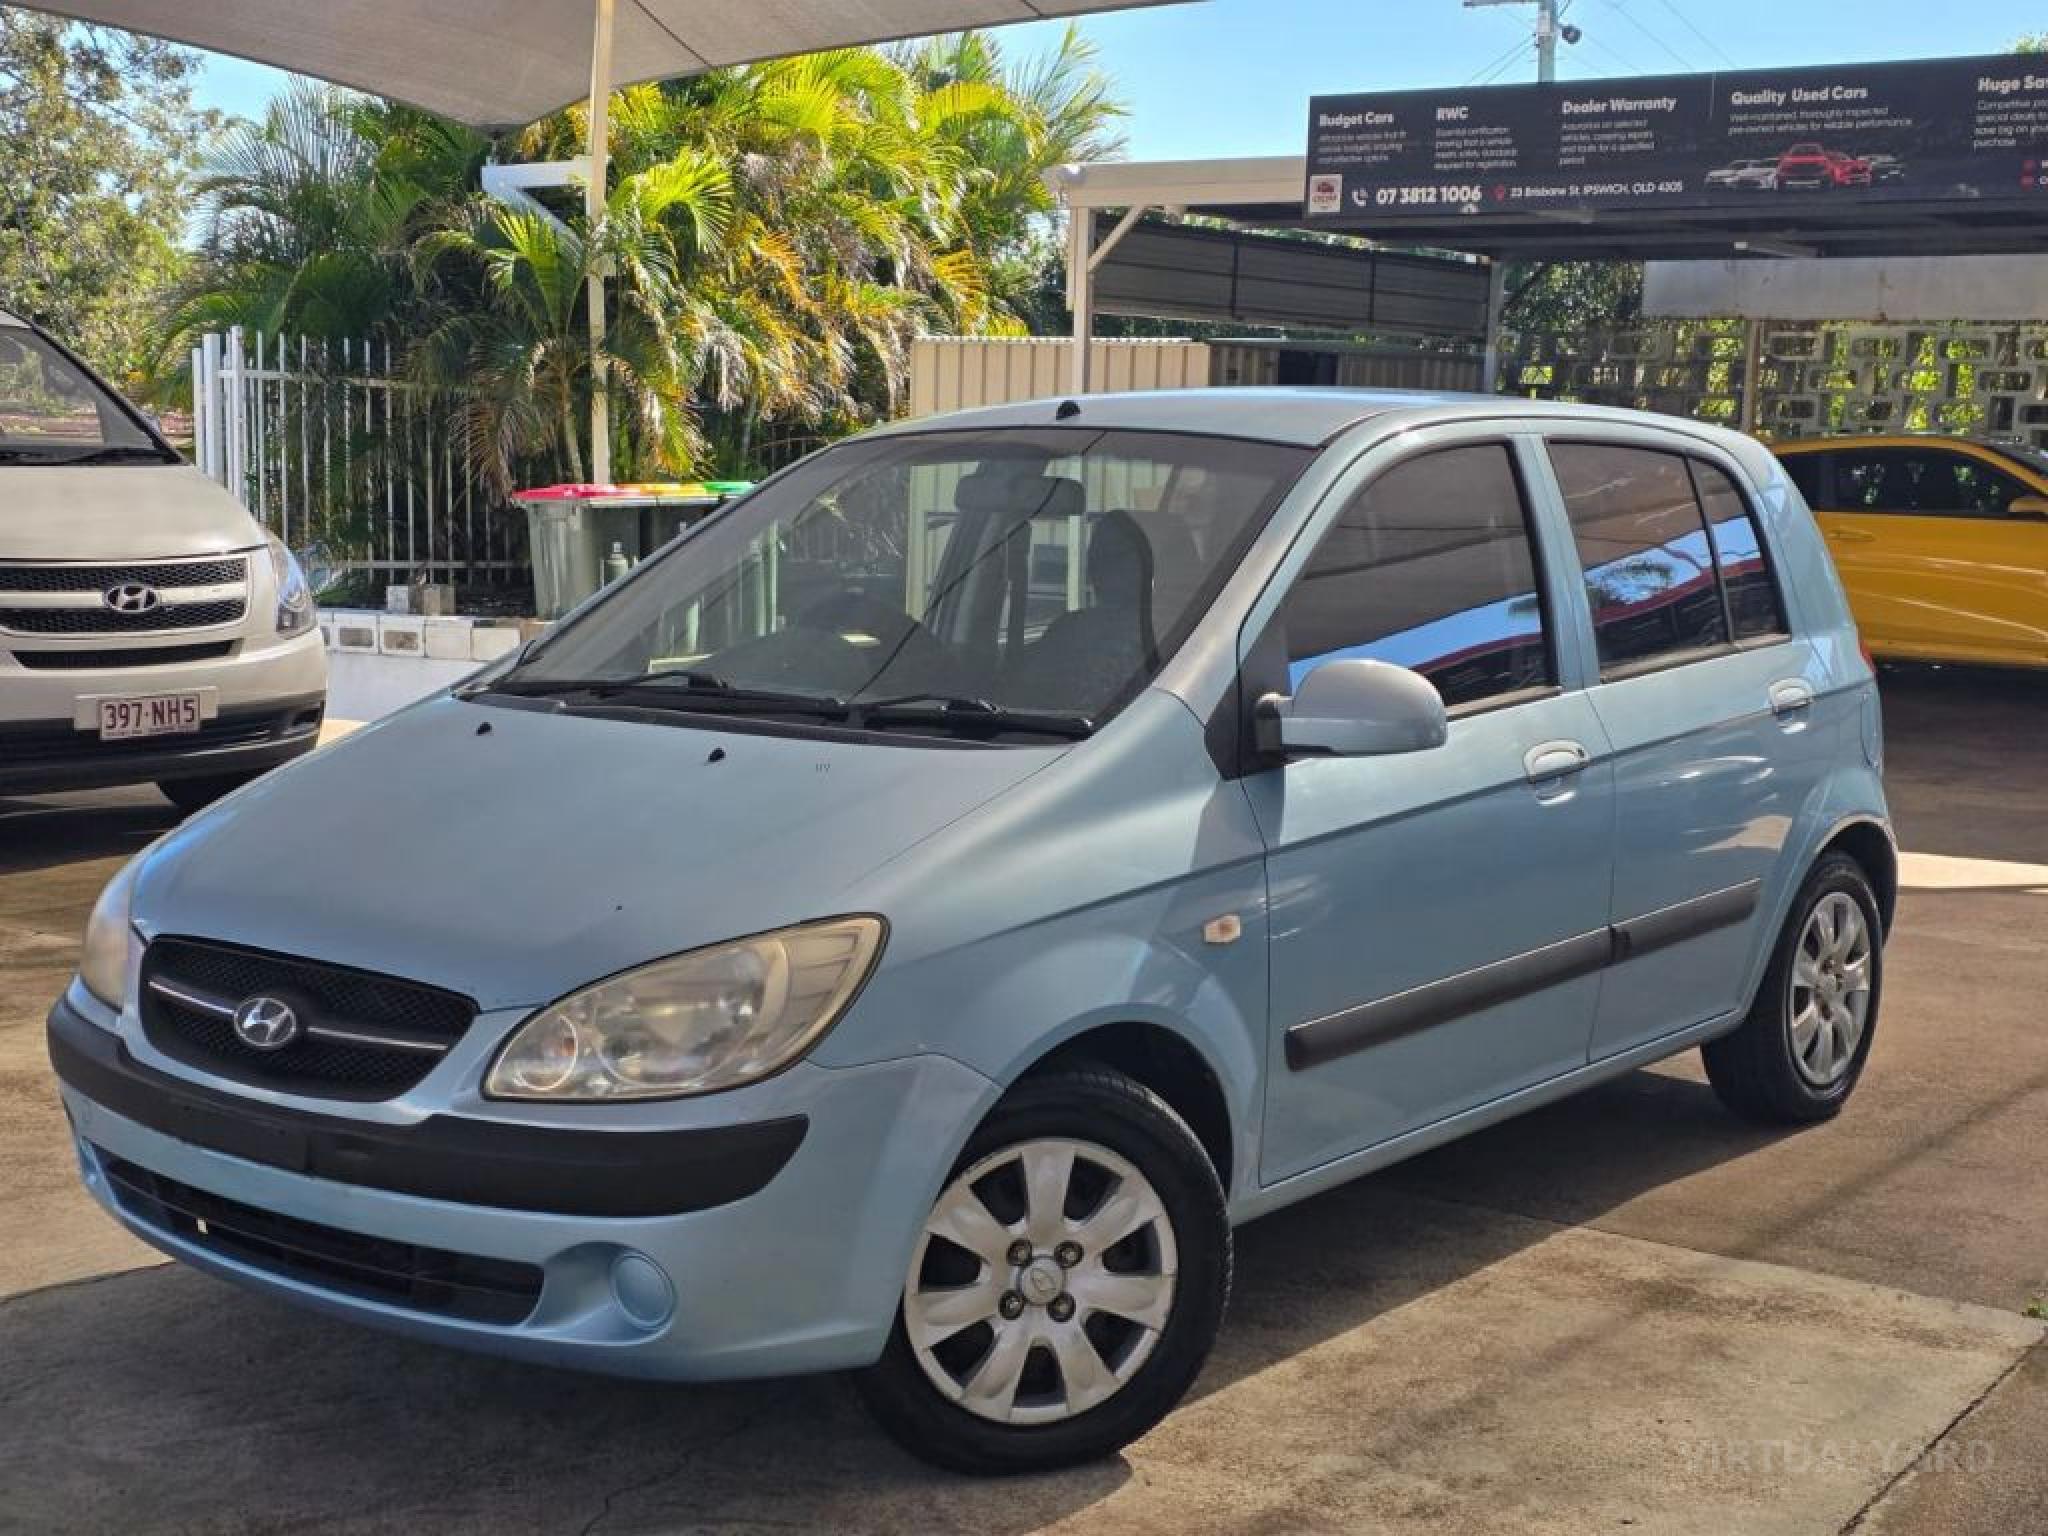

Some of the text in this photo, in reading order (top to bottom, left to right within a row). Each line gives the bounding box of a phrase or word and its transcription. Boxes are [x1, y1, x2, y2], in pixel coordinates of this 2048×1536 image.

[1977, 75, 2048, 94] Huge Sa
[1731, 85, 1869, 106] Quality Used Cars
[1436, 106, 1469, 121] RWC
[1561, 97, 1677, 114] Dealer Warranty
[1319, 112, 1394, 129] Budget Cars
[1376, 185, 1483, 204] 07 3812 1006
[1632, 181, 1655, 194] QLD
